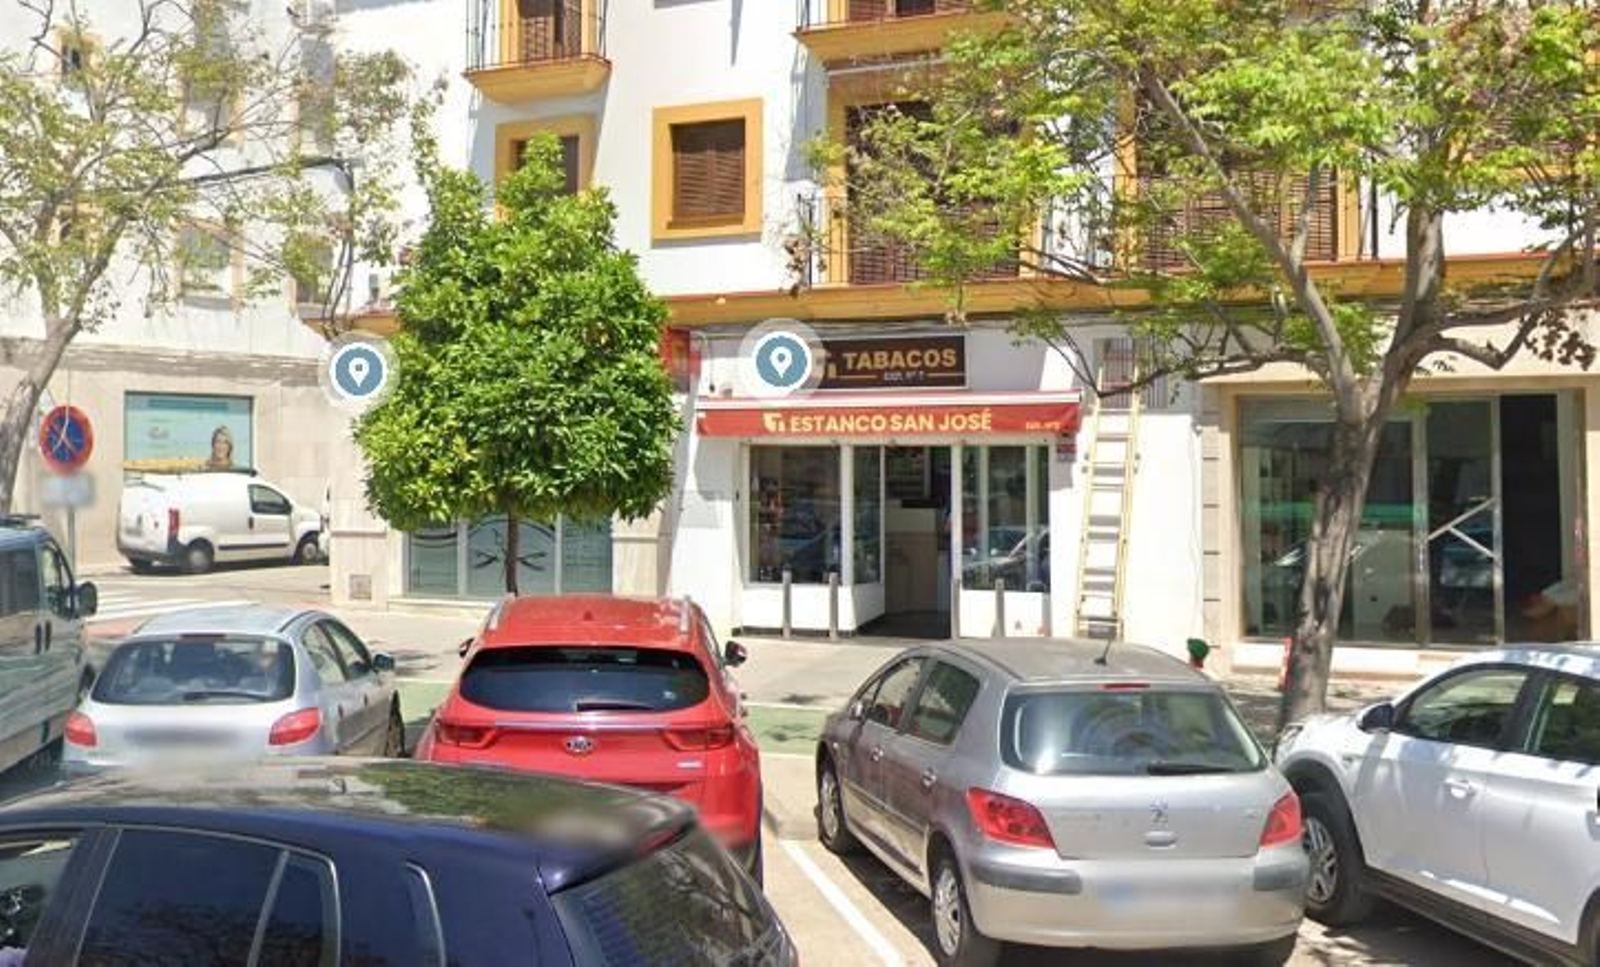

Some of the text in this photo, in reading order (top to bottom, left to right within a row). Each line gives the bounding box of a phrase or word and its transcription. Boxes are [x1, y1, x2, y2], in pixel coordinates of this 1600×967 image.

[842, 348, 956, 370] TABACOS
[790, 408, 992, 432] ESTANCO SAN JOSÉ
